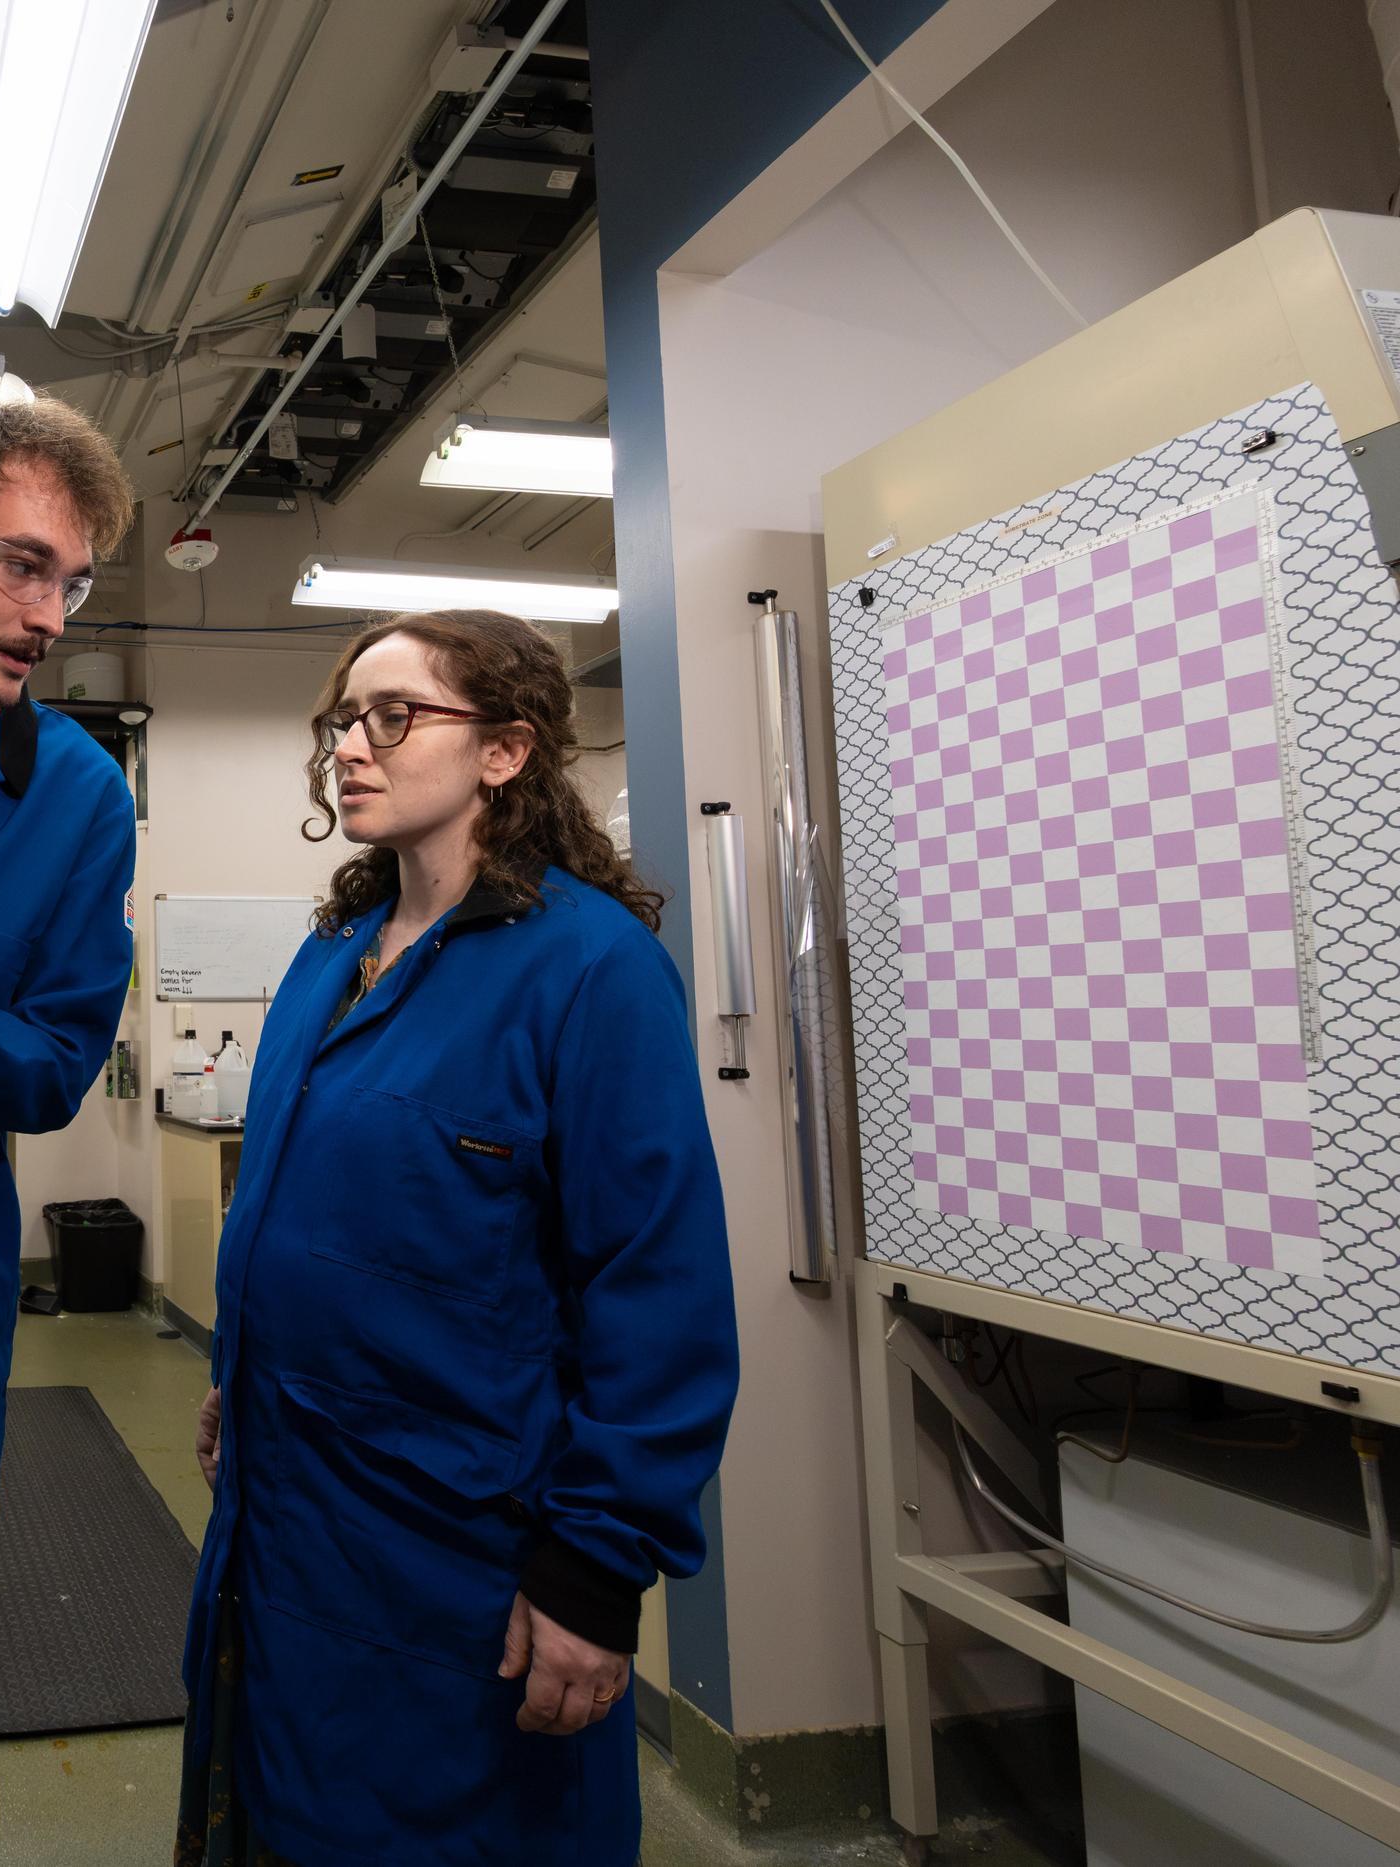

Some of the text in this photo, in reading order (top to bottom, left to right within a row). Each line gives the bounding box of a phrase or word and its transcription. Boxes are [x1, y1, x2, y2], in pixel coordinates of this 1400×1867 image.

[1037, 511, 1053, 521] ZONE
[160, 968, 179, 976] Empty
[460, 1138, 494, 1153] Workrite
